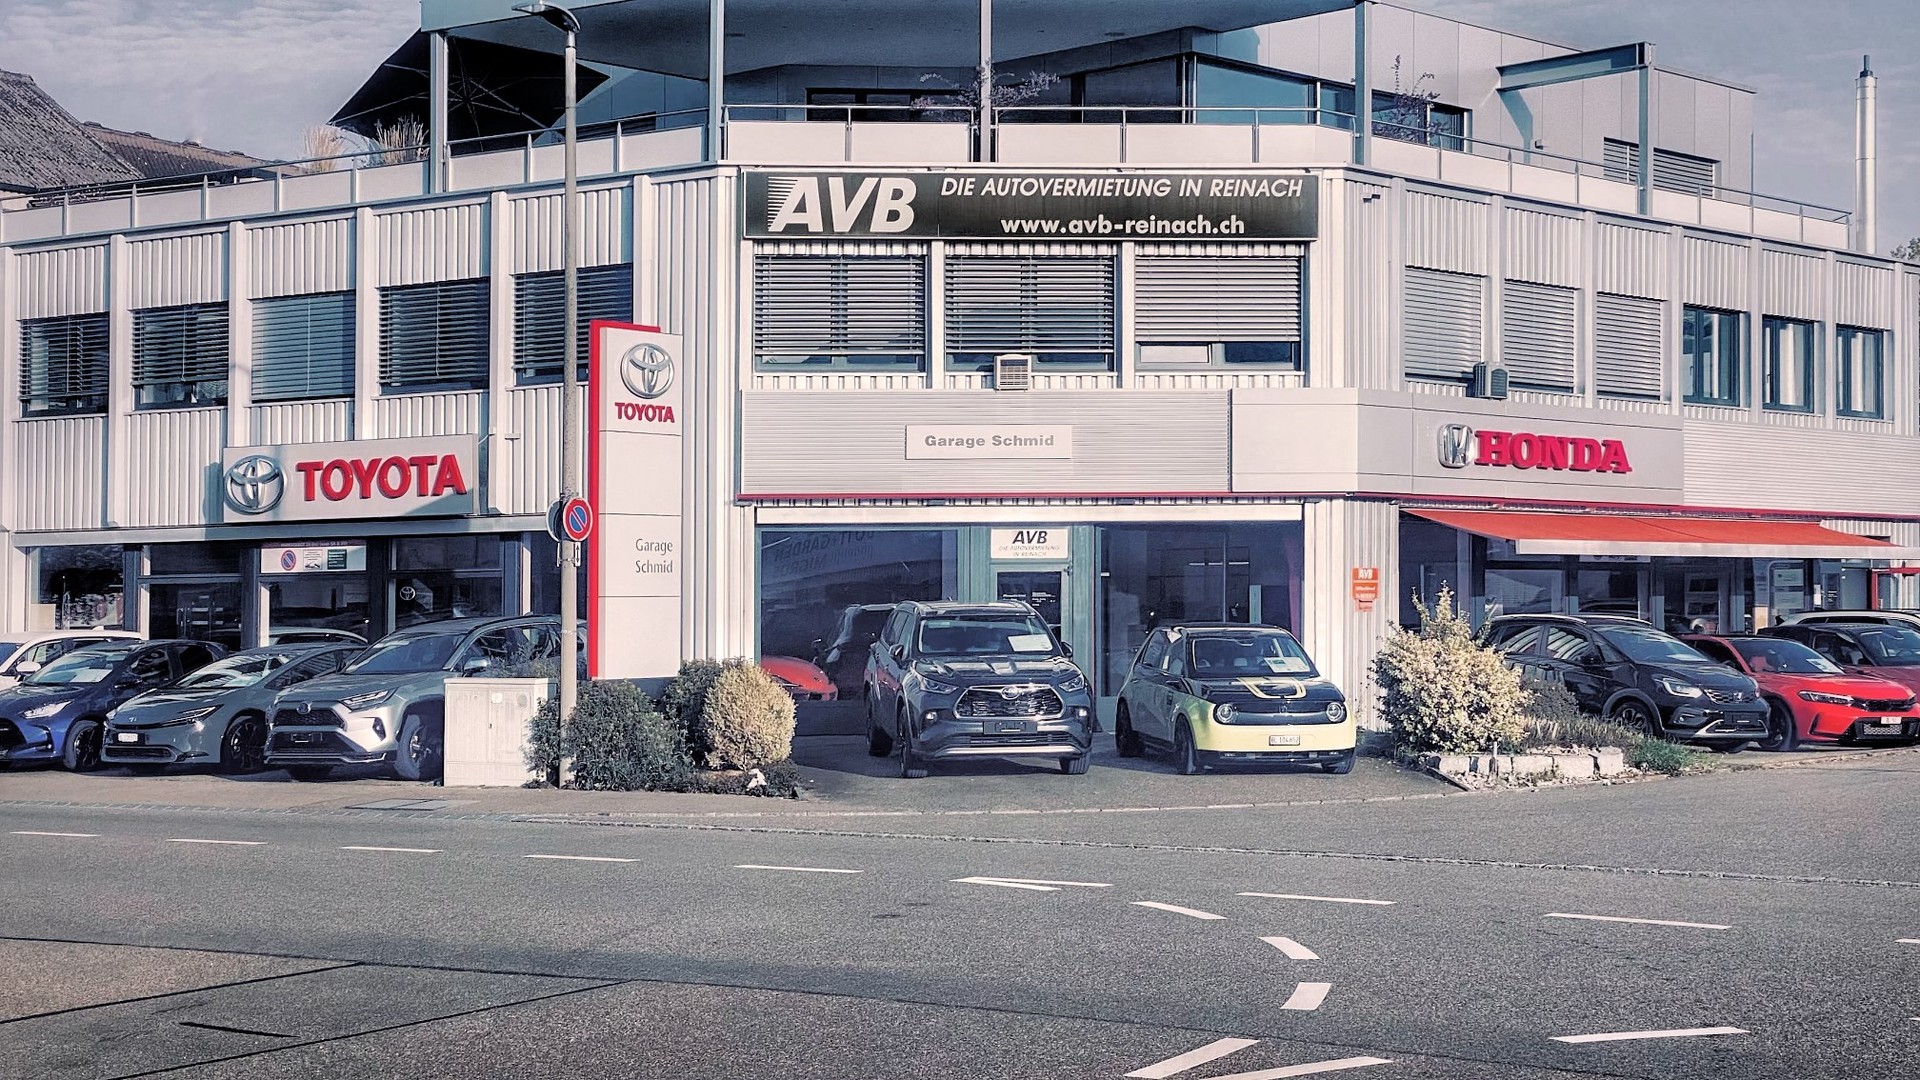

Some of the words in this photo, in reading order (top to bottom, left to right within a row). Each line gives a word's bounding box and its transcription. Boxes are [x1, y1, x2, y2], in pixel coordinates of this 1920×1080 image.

[941, 178, 975, 196] DIE
[981, 178, 1171, 197] AUTOVERMIETUNG
[1179, 179, 1202, 197] IN
[1209, 179, 1303, 197] REINACH
[768, 177, 917, 232] AVB
[1001, 215, 1245, 234] www.avb-reinach.ch
[614, 402, 675, 423] TOYOTA
[924, 435, 986, 449] Garage
[991, 435, 1054, 447] Schmid
[1474, 430, 1632, 473] HONDA
[295, 454, 467, 501] TOYOTA
[1012, 530, 1048, 544] AVB
[635, 538, 673, 556] Garage
[635, 560, 673, 573] Schmid
